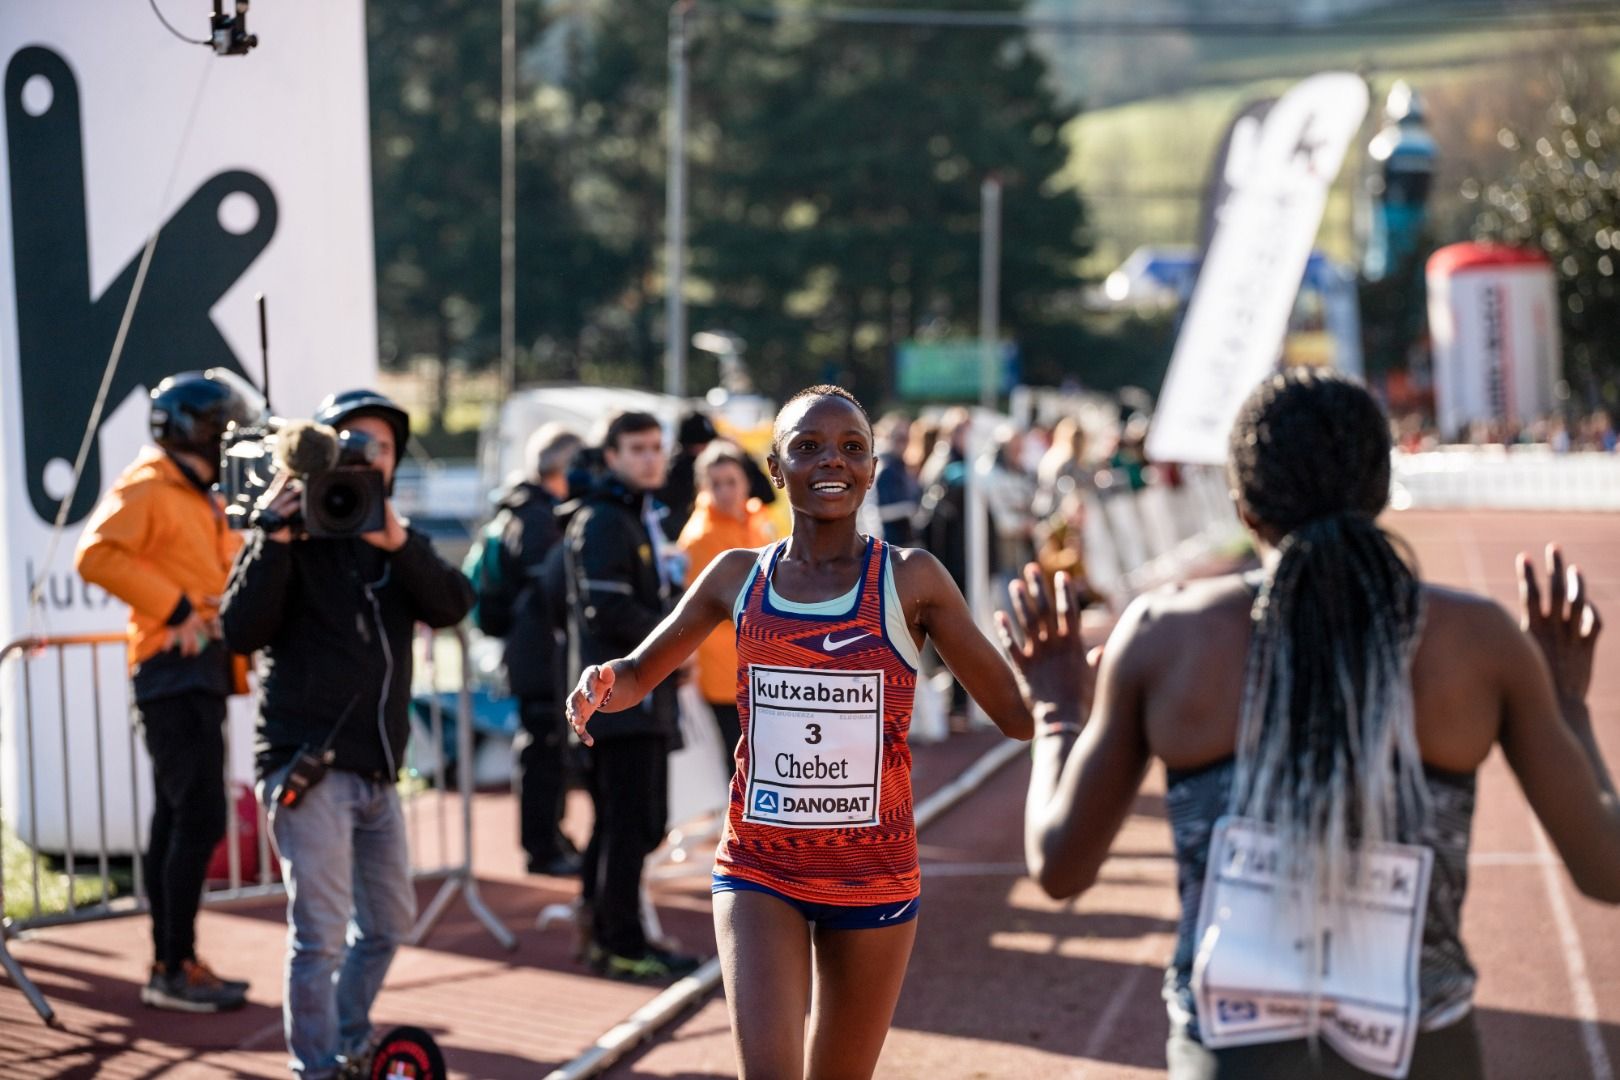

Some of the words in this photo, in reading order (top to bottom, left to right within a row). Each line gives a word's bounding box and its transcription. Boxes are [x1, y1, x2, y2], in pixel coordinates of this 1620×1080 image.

[757, 678, 873, 703] kutxabank
[804, 723, 822, 745] 3
[775, 753, 848, 779] Chebet
[783, 797, 870, 813] DANOBAT
